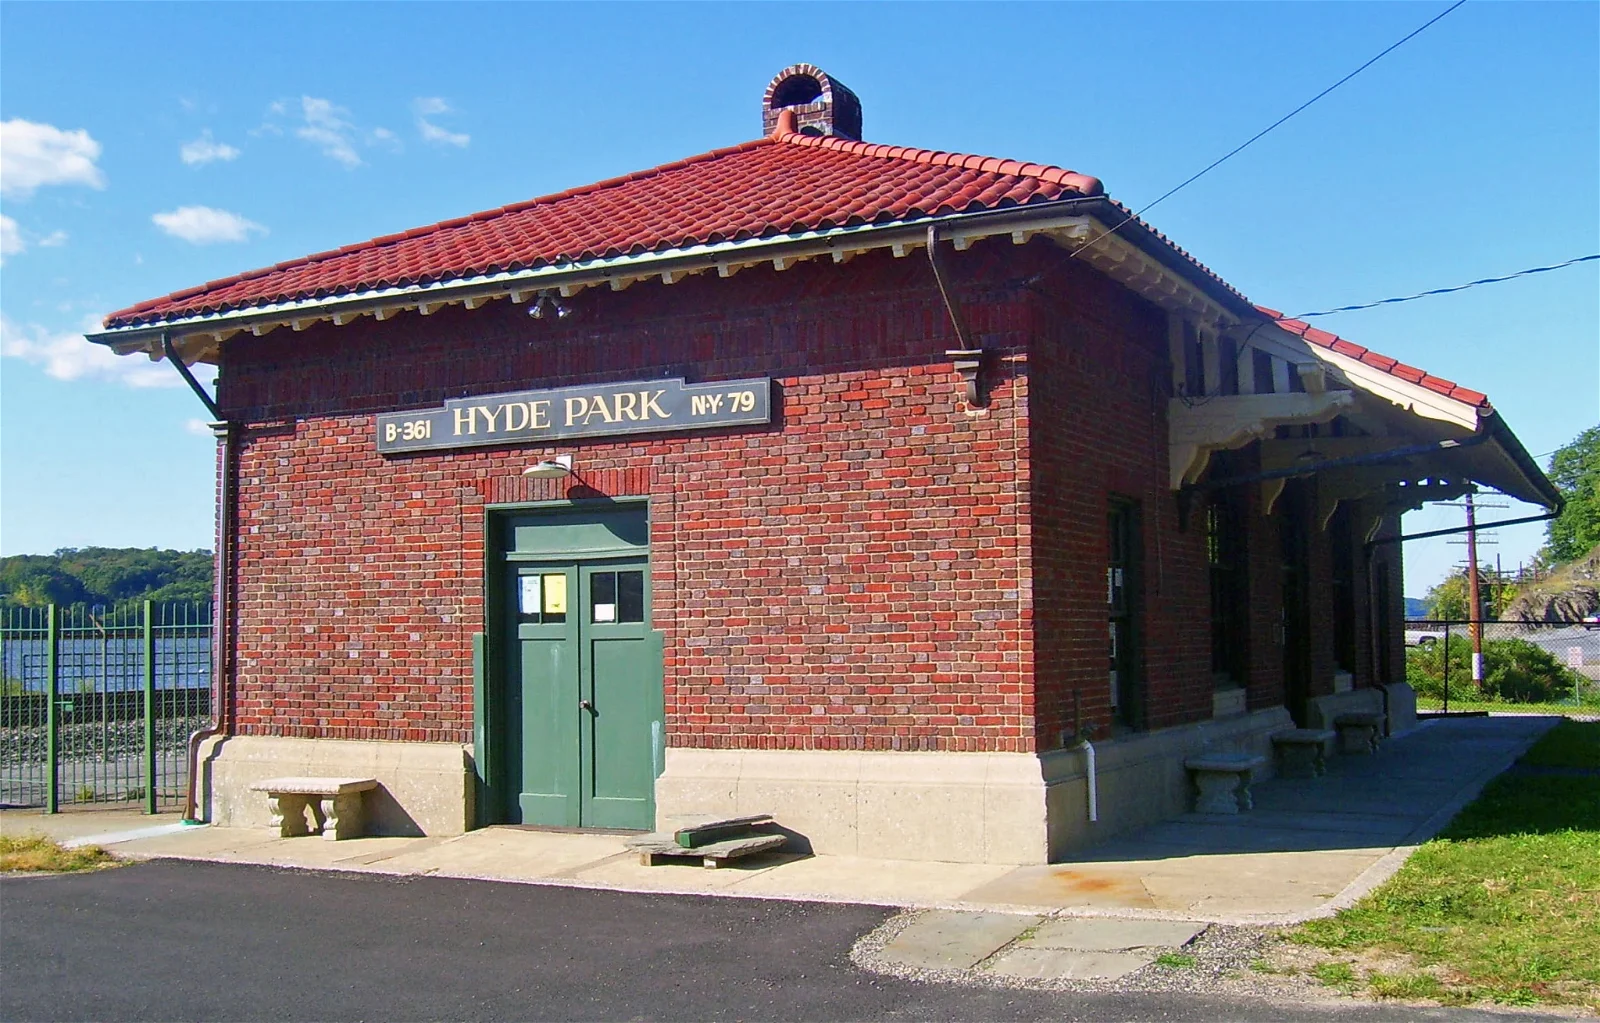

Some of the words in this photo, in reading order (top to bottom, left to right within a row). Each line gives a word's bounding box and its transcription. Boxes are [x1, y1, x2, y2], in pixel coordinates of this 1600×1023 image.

[385, 419, 431, 442] B-361
[453, 400, 550, 436] HYDE
[564, 389, 672, 427] PARK
[727, 390, 755, 413] 79
